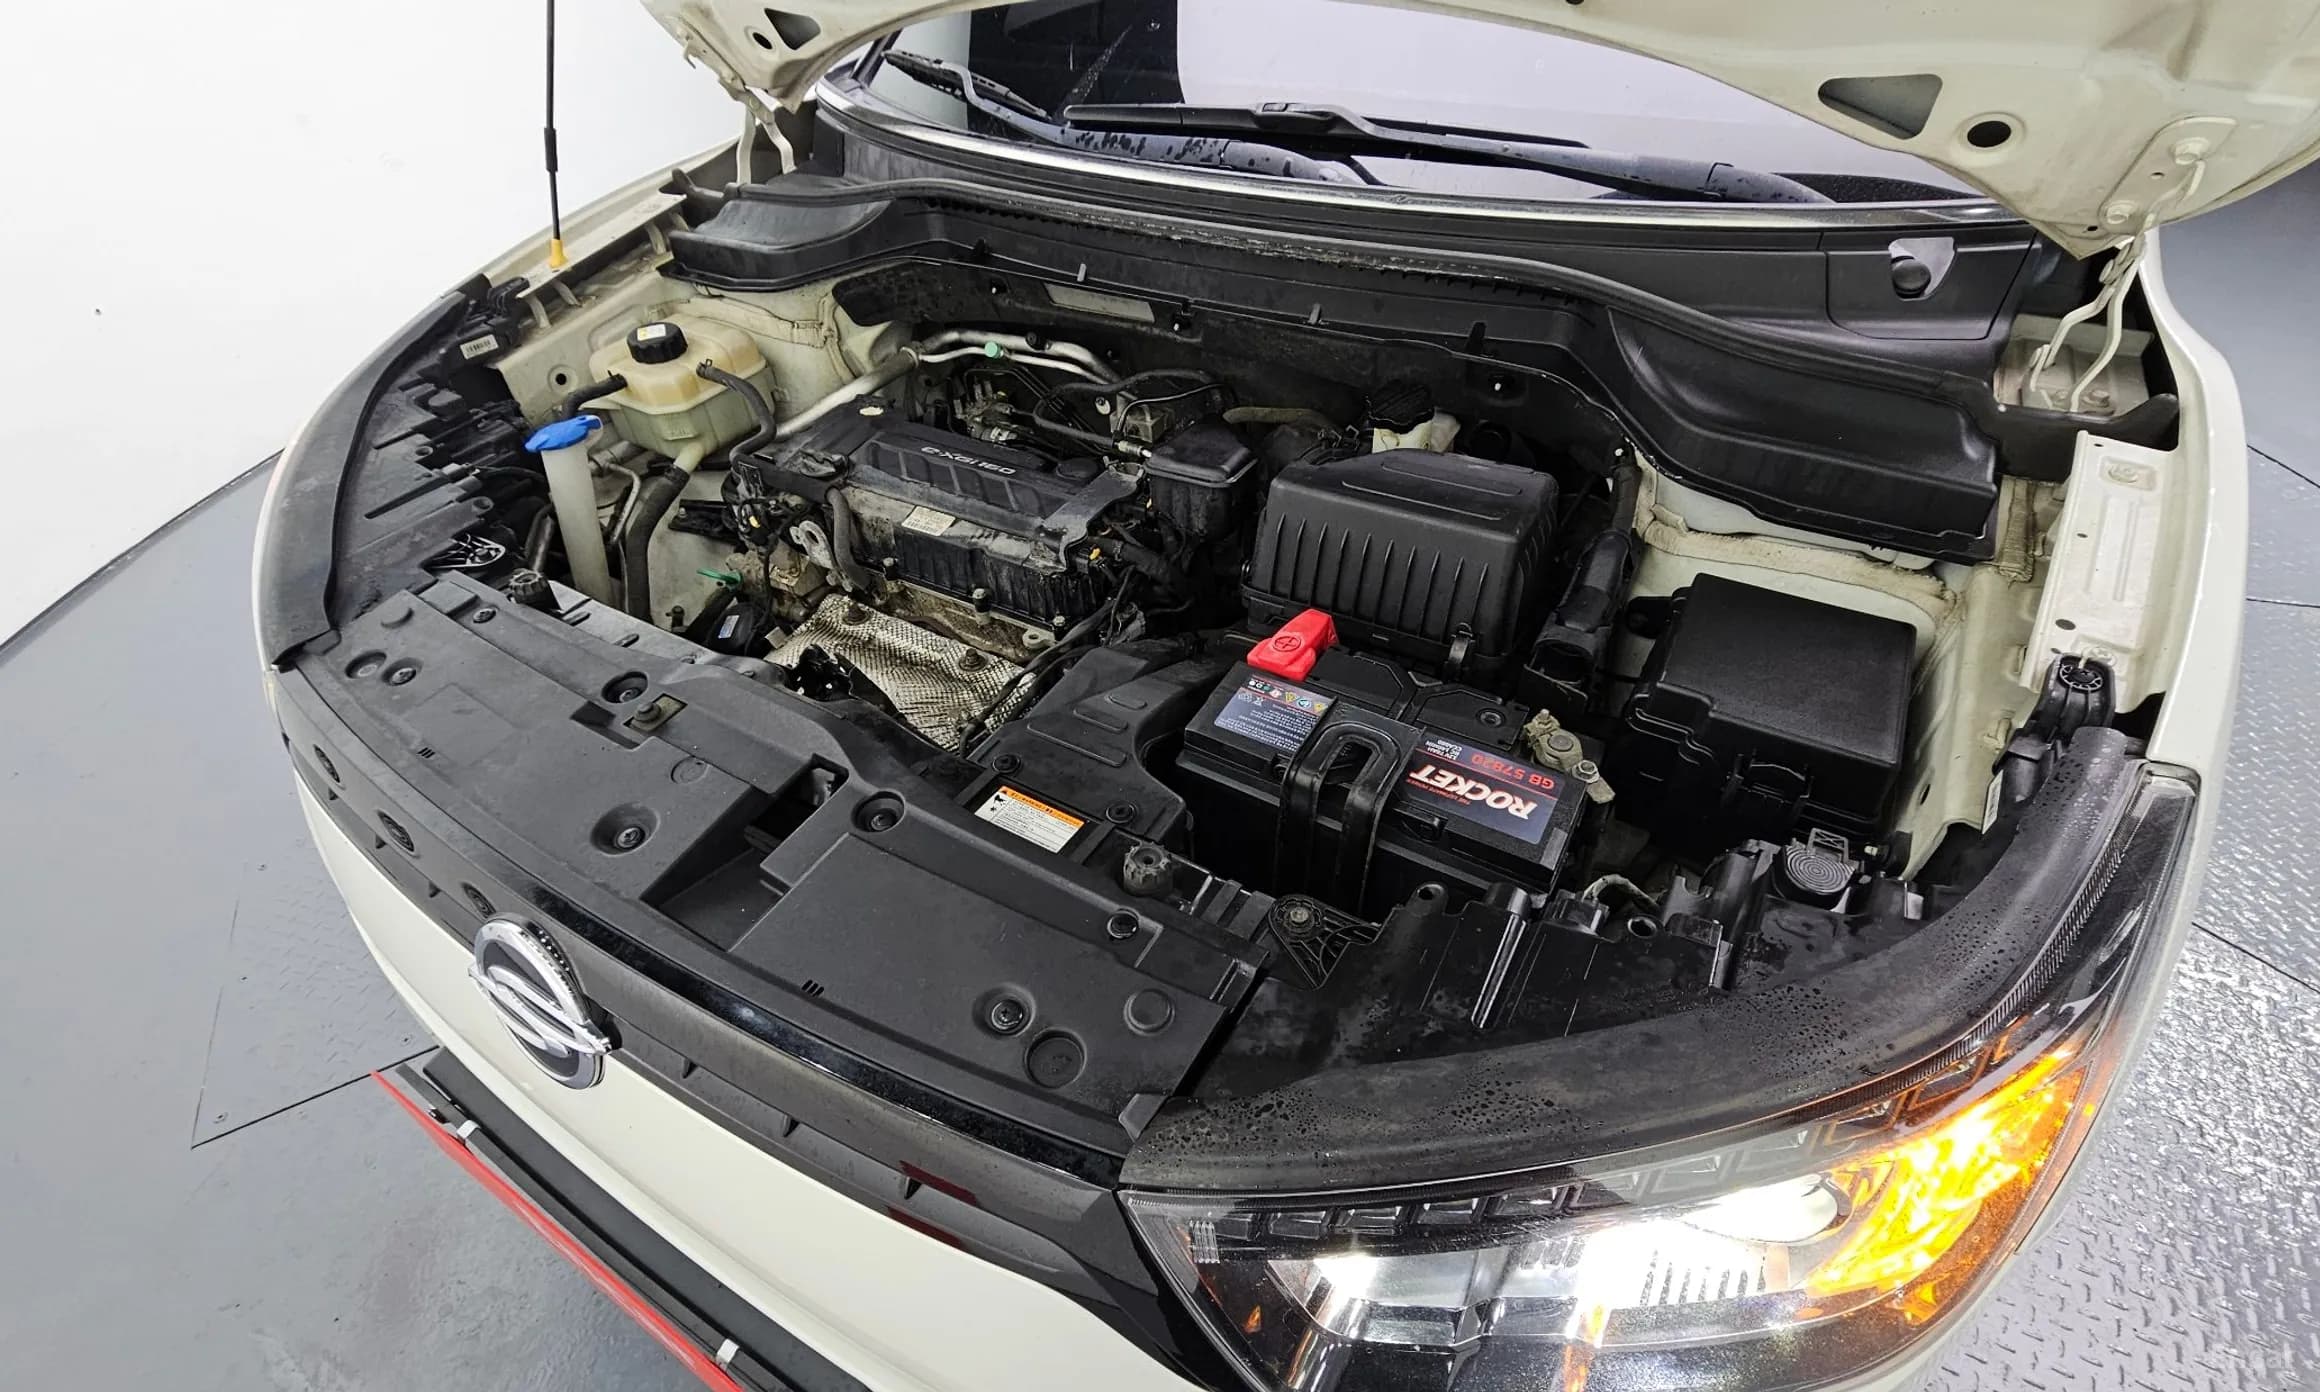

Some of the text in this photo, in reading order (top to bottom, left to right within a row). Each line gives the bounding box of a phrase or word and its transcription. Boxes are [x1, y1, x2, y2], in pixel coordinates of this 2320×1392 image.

[1409, 764, 1538, 820] ROCKET
[1471, 753, 1555, 790] GB 57820
